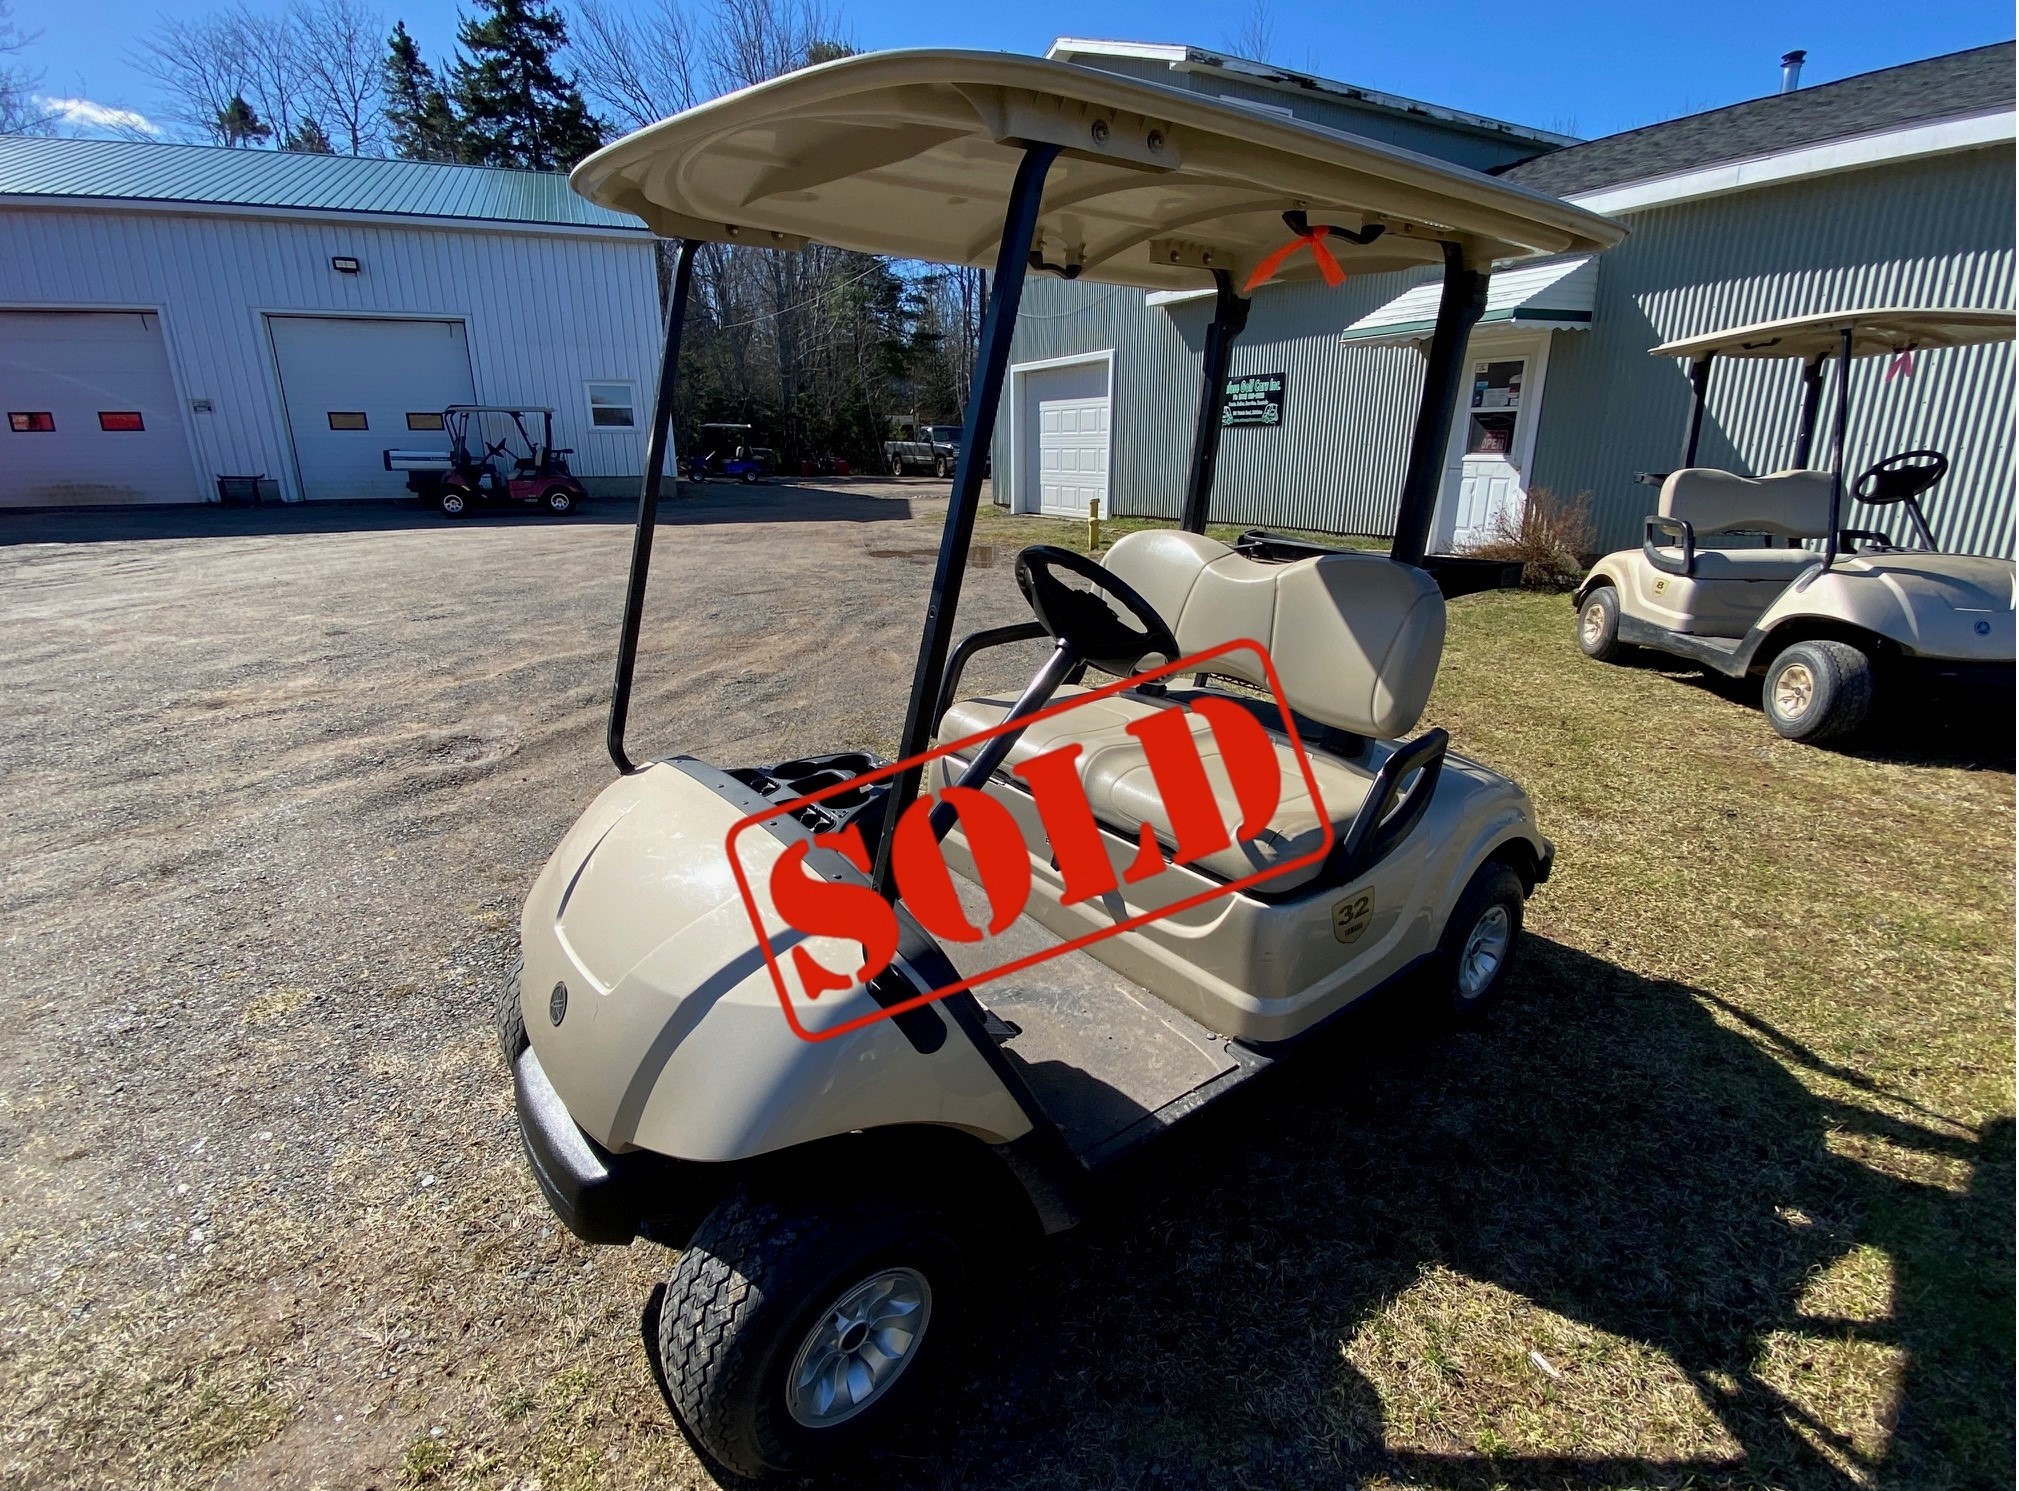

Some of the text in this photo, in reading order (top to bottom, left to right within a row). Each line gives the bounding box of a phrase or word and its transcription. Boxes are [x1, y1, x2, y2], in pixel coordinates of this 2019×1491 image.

[1241, 379, 1254, 393] Golf
[1481, 438, 1505, 449] OPEN
[1656, 581, 1664, 589] 8
[1338, 896, 1369, 926] 32
